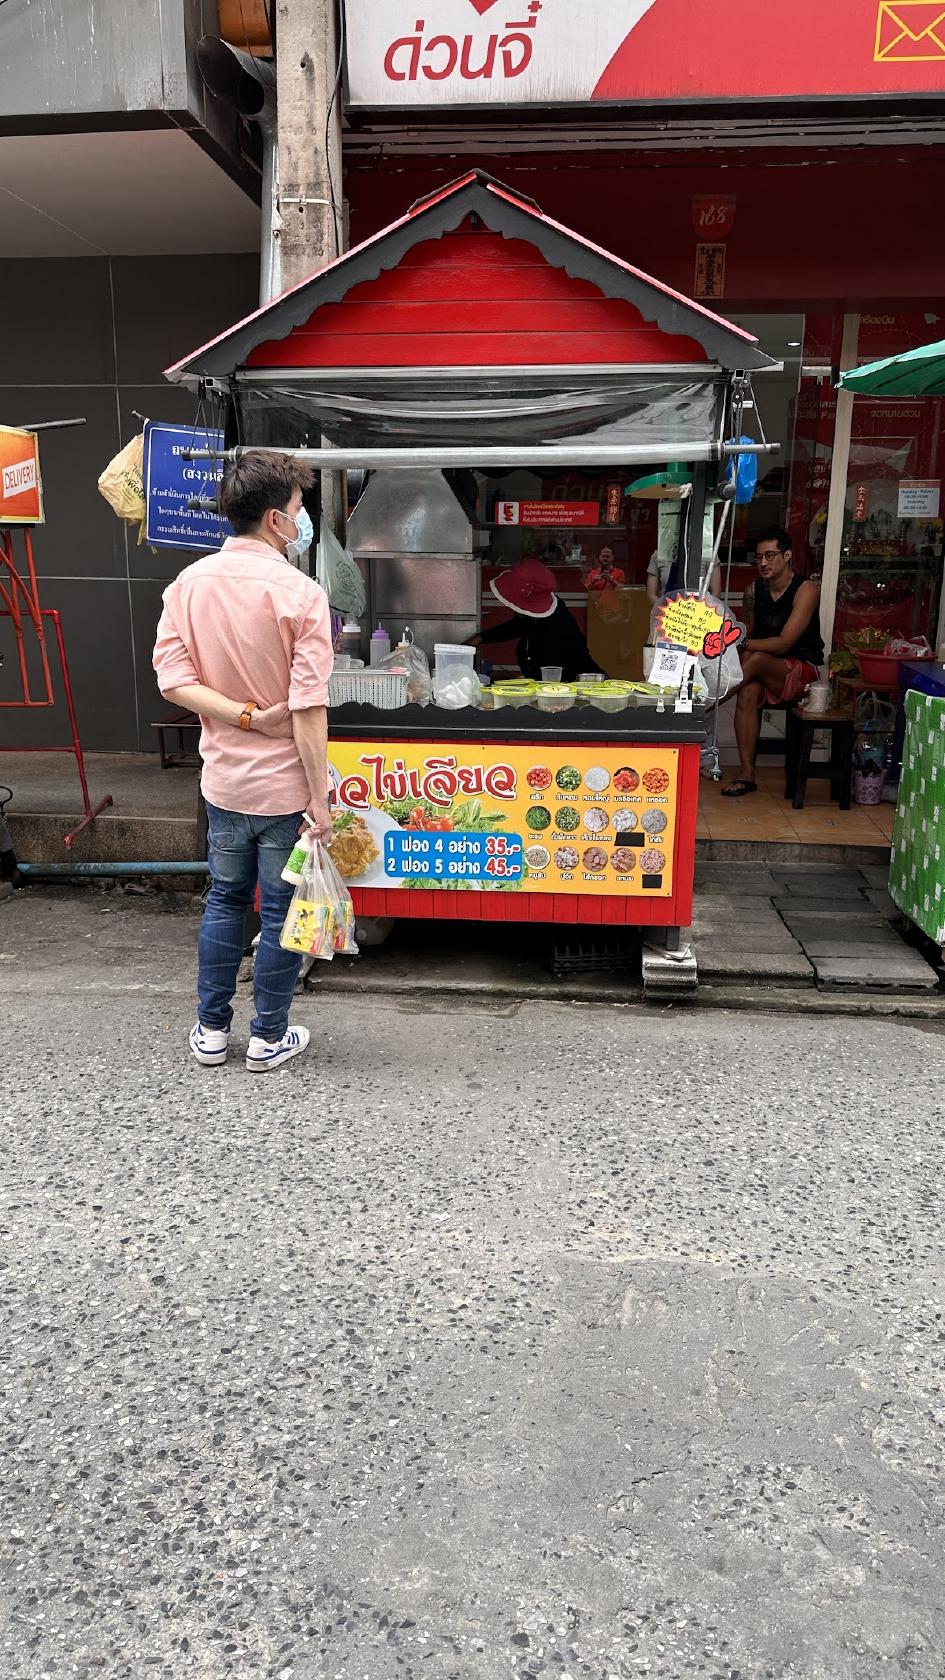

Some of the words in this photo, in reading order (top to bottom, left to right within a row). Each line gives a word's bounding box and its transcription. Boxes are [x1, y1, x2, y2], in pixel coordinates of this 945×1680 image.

[384, 0, 543, 81] ด่วนจี๋
[699, 205, 729, 226] 168
[4, 463, 34, 490] DELIVERY
[388, 837, 394, 852] 1
[402, 838, 429, 853] ฟอง
[434, 838, 444, 853] 4
[448, 836, 481, 854] อย่าง
[485, 837, 522, 856] 35.-
[388, 858, 396, 873] 2
[402, 859, 429, 873] ฟอง
[434, 859, 443, 873] 5
[448, 856, 481, 875] อย่าง
[484, 858, 522, 877] 45.-
